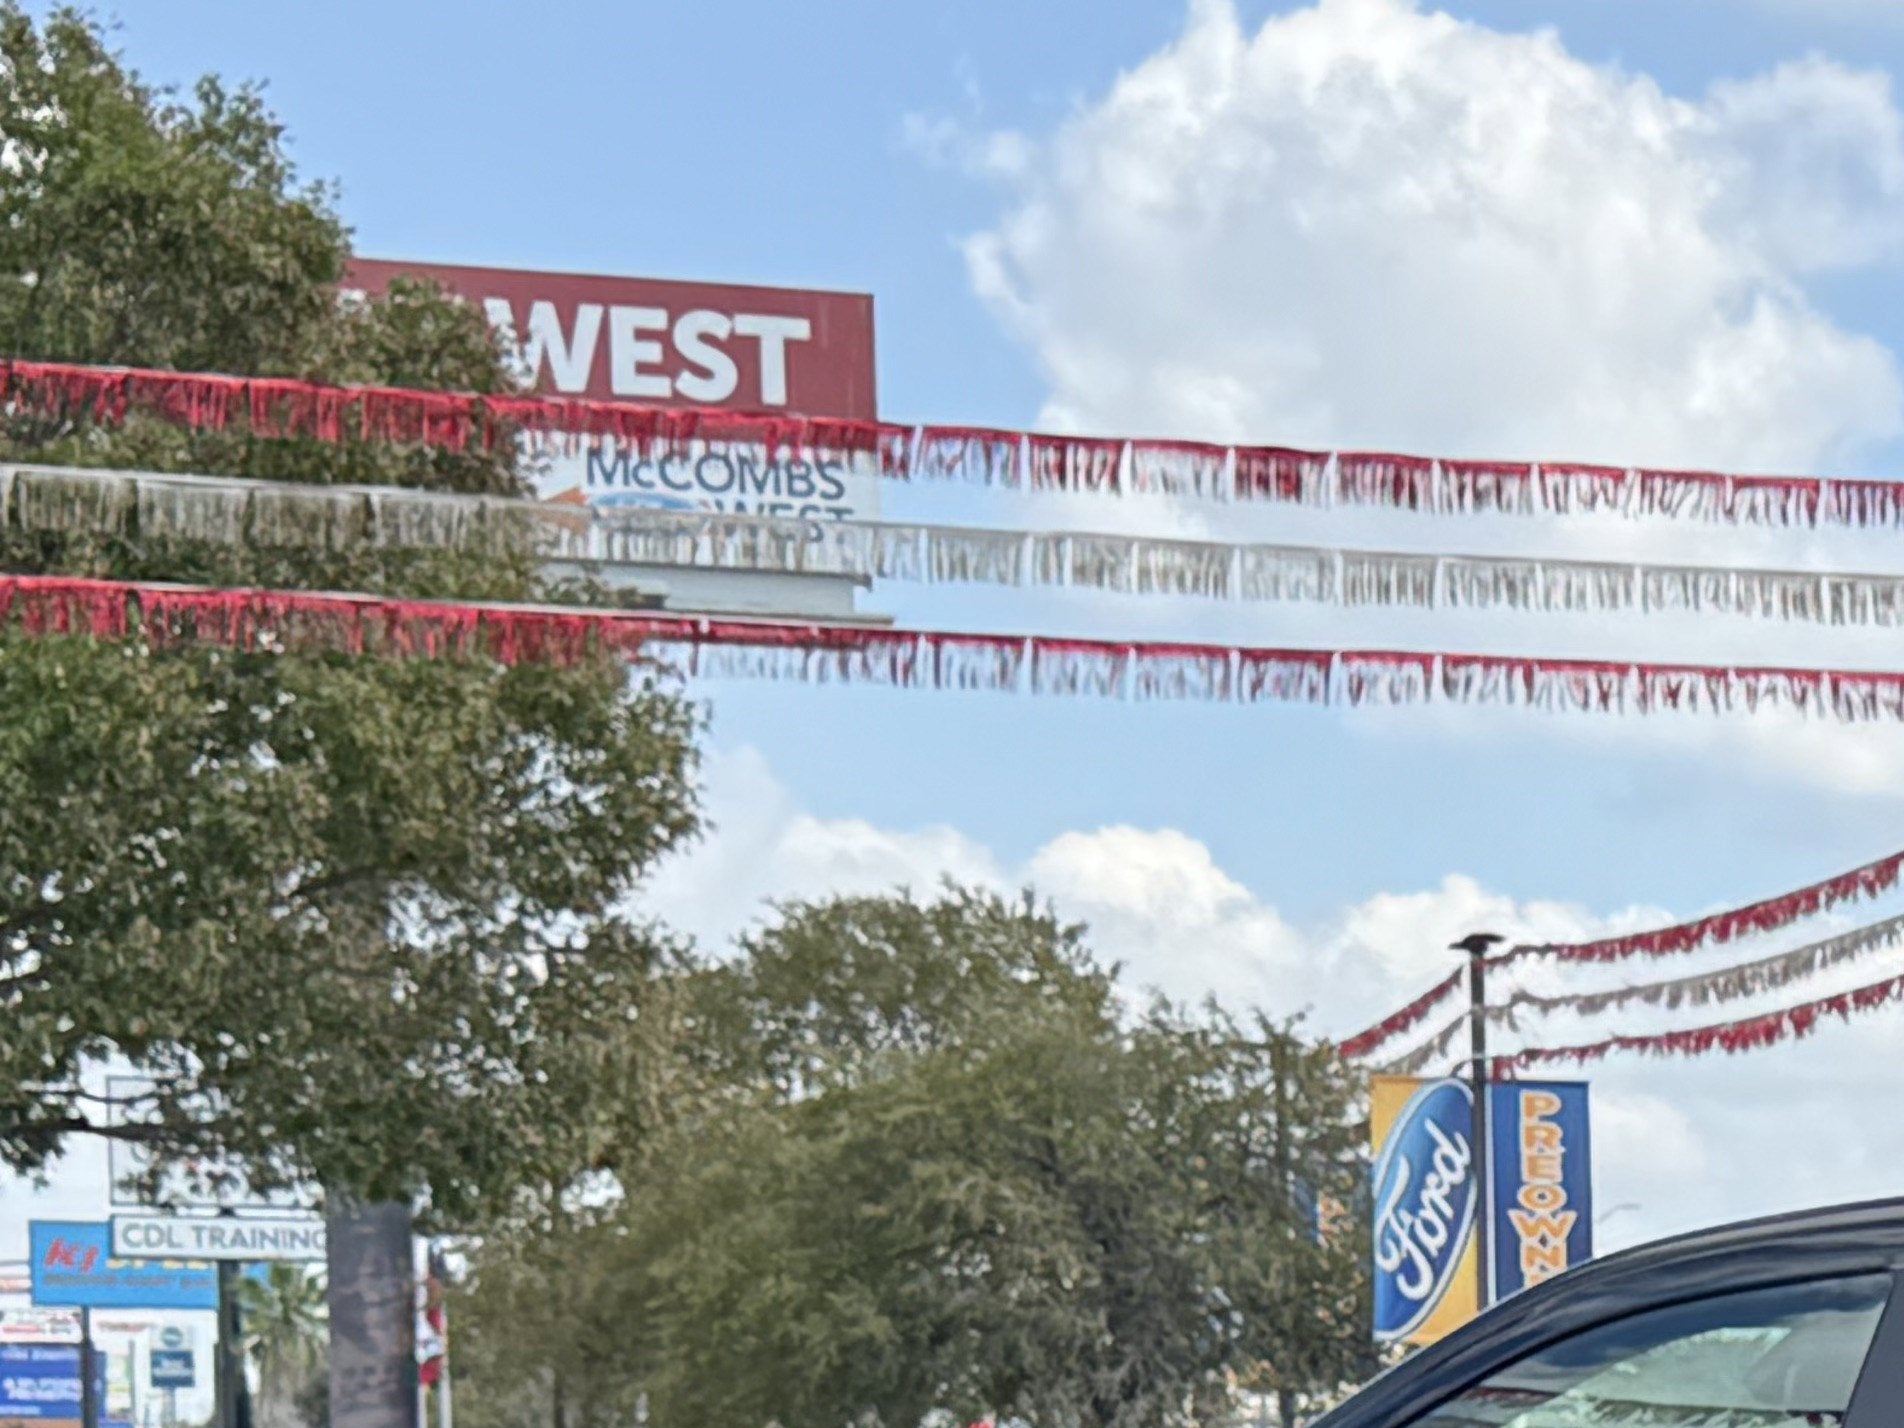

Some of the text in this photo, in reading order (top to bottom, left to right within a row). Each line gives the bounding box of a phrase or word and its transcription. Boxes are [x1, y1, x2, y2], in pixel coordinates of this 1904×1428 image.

[482, 297, 812, 406] WEST
[585, 446, 846, 502] McCOMBS
[122, 1222, 183, 1249] CDL
[1374, 1117, 1471, 1300] Ford
[1507, 1088, 1578, 1291] PREOWN
